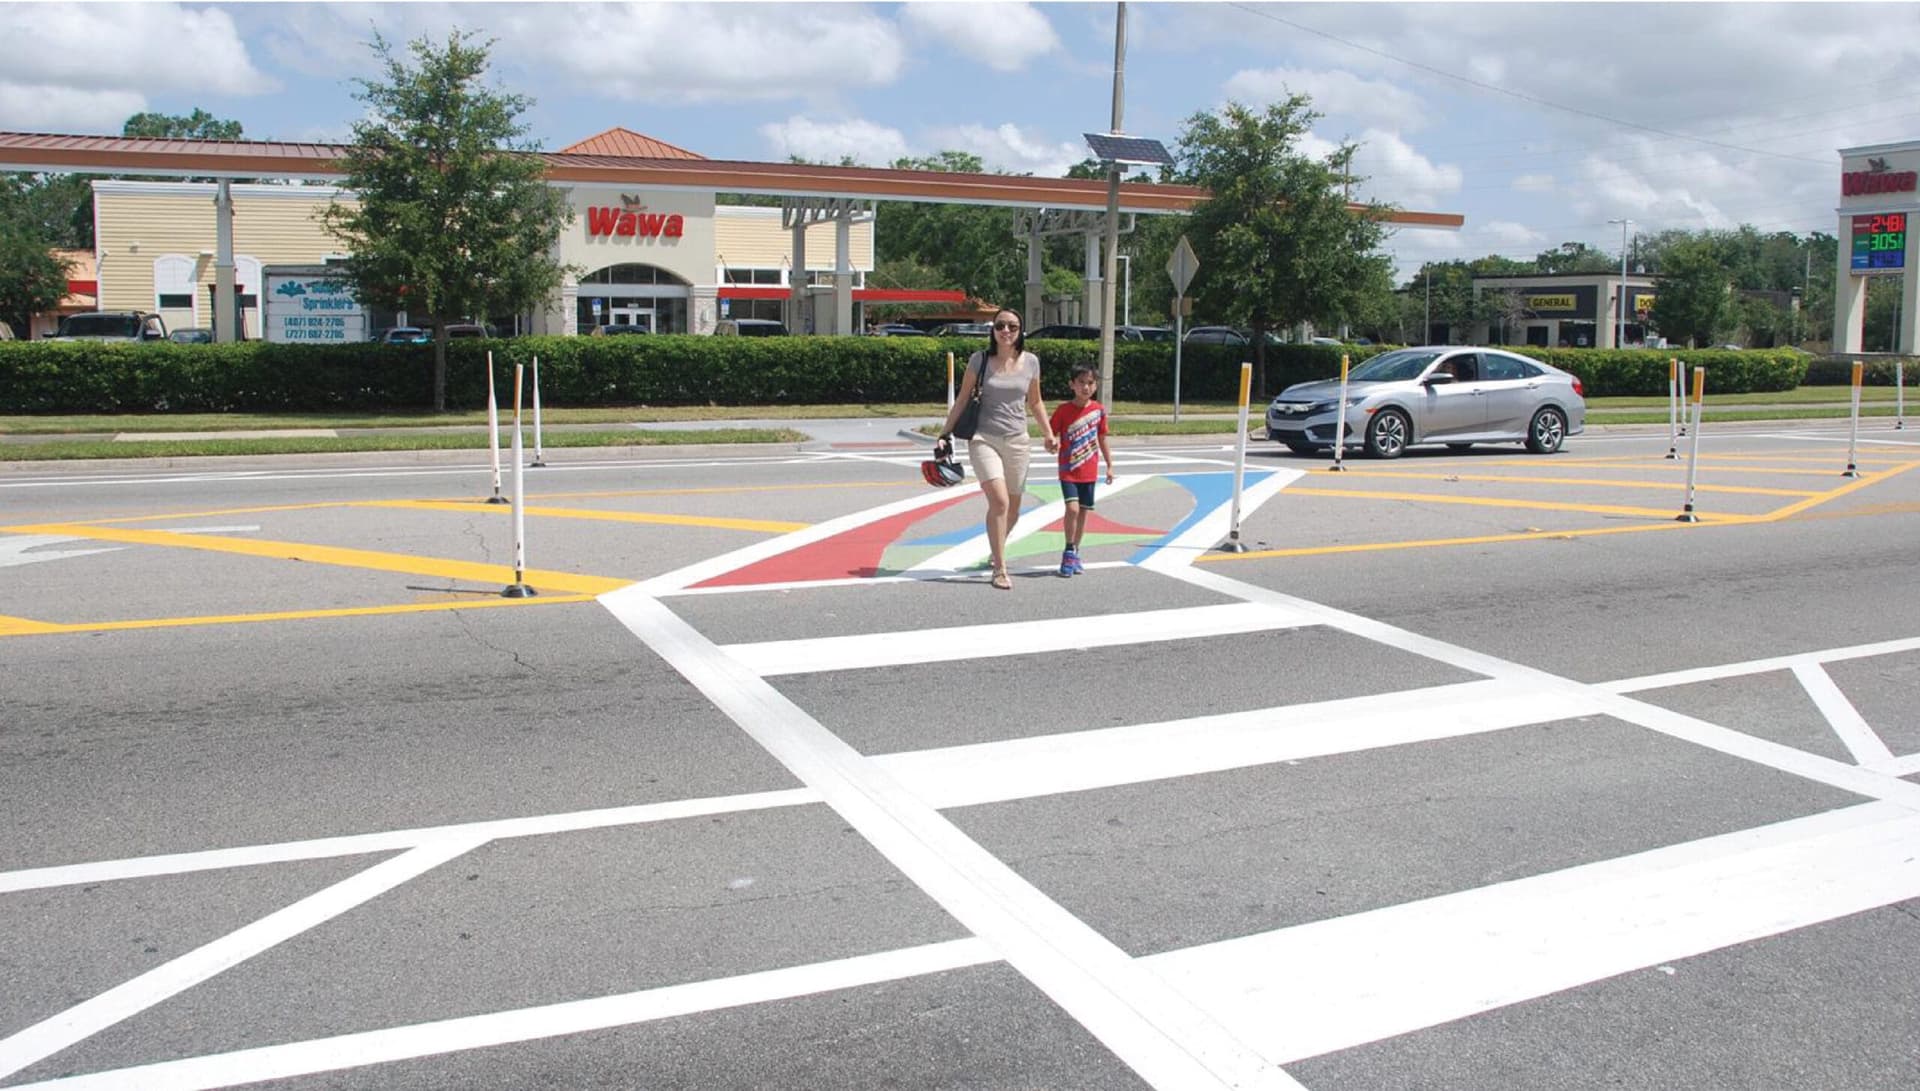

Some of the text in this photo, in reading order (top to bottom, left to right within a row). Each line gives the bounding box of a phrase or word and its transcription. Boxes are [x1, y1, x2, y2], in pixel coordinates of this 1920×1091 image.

[1842, 171, 1917, 196] Wawa
[588, 206, 684, 237] Wawa
[1532, 298, 1572, 307] GENERAL
